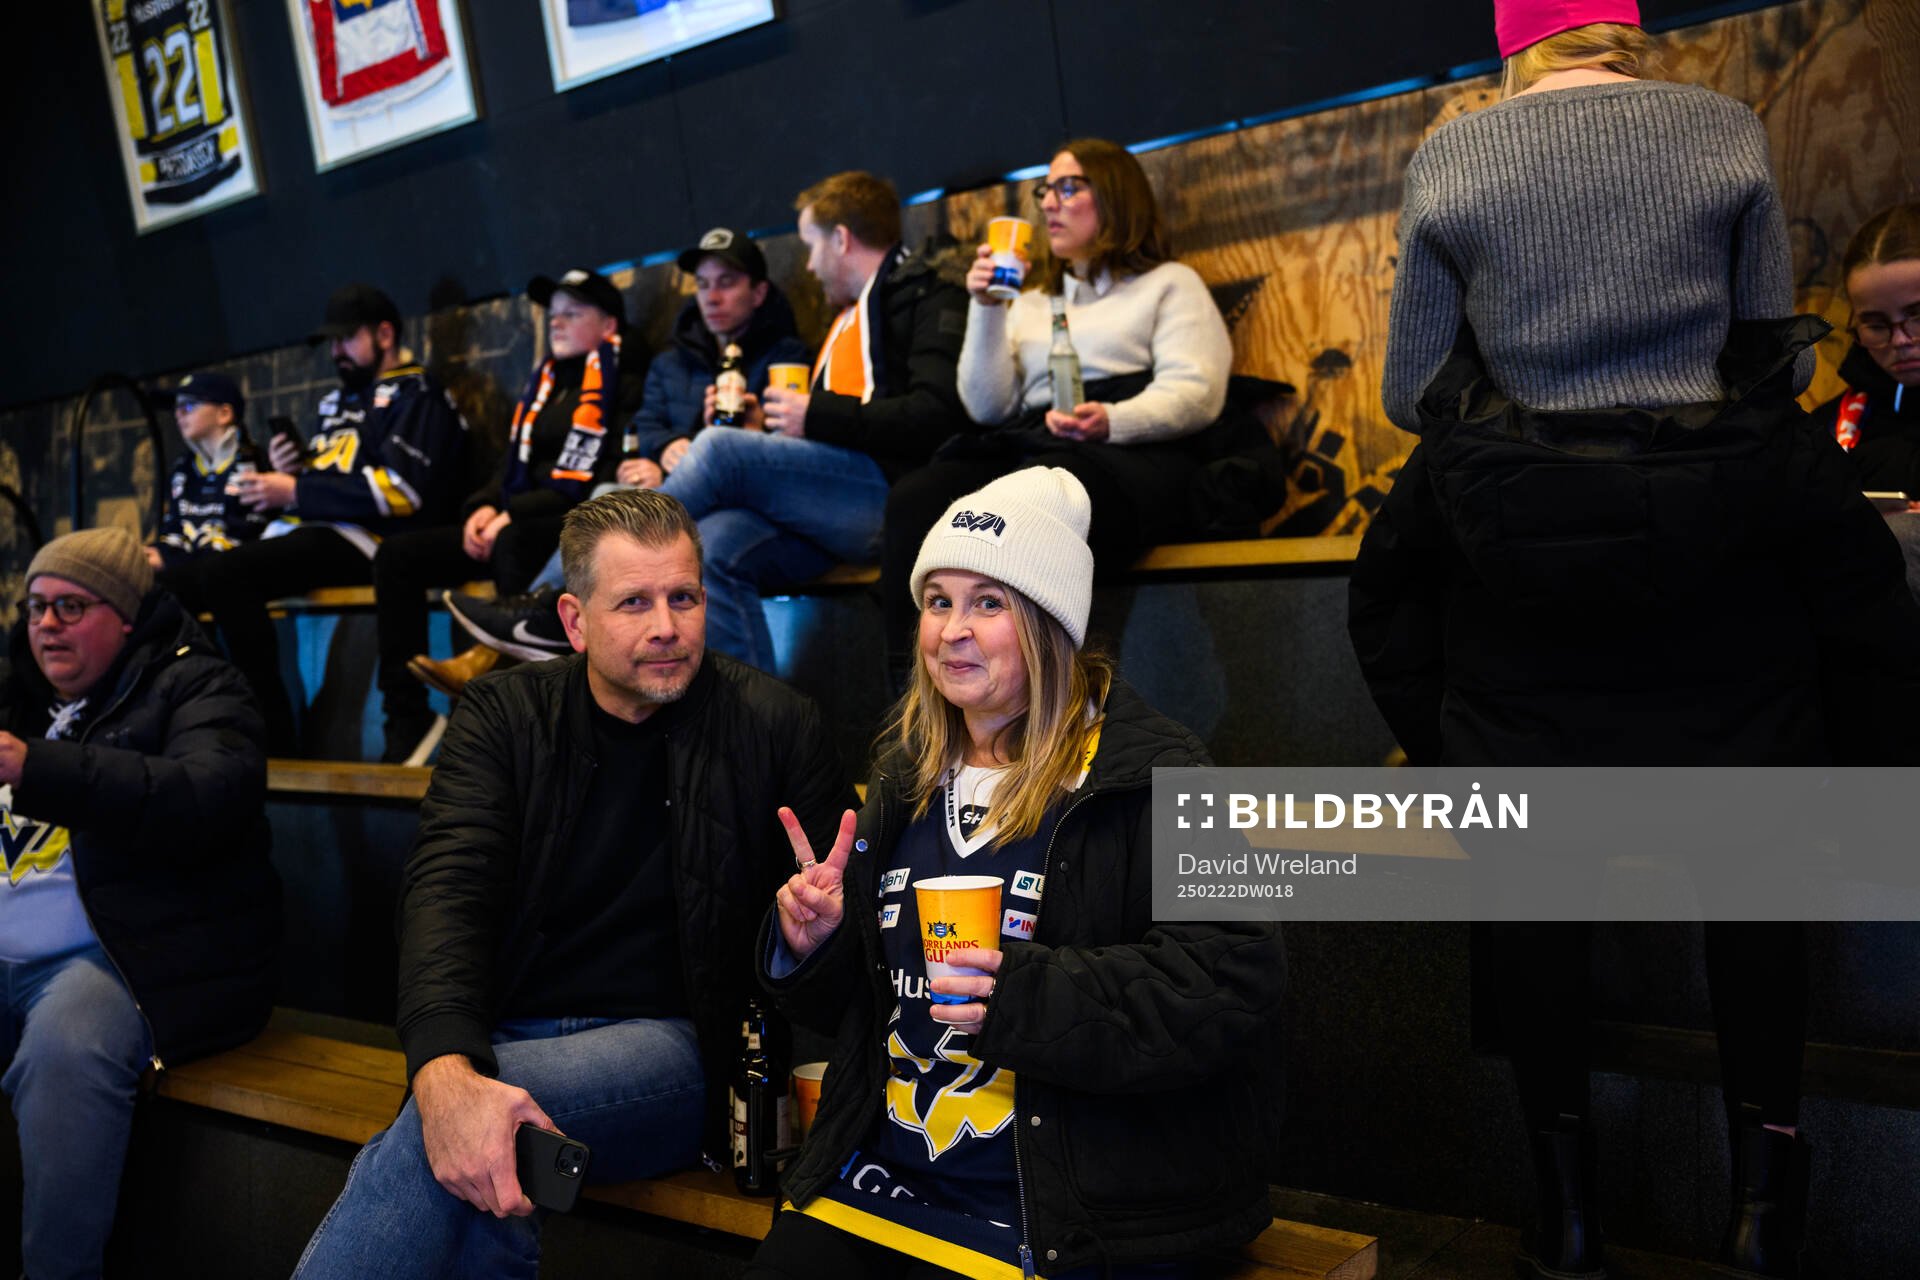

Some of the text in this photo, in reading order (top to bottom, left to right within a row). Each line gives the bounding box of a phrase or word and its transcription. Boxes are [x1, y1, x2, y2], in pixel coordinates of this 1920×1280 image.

[186, 0, 211, 32] 22
[143, 27, 203, 137] 22
[962, 811, 985, 825] SH
[923, 939, 979, 949] ORRLANDS
[925, 949, 950, 963] GU
